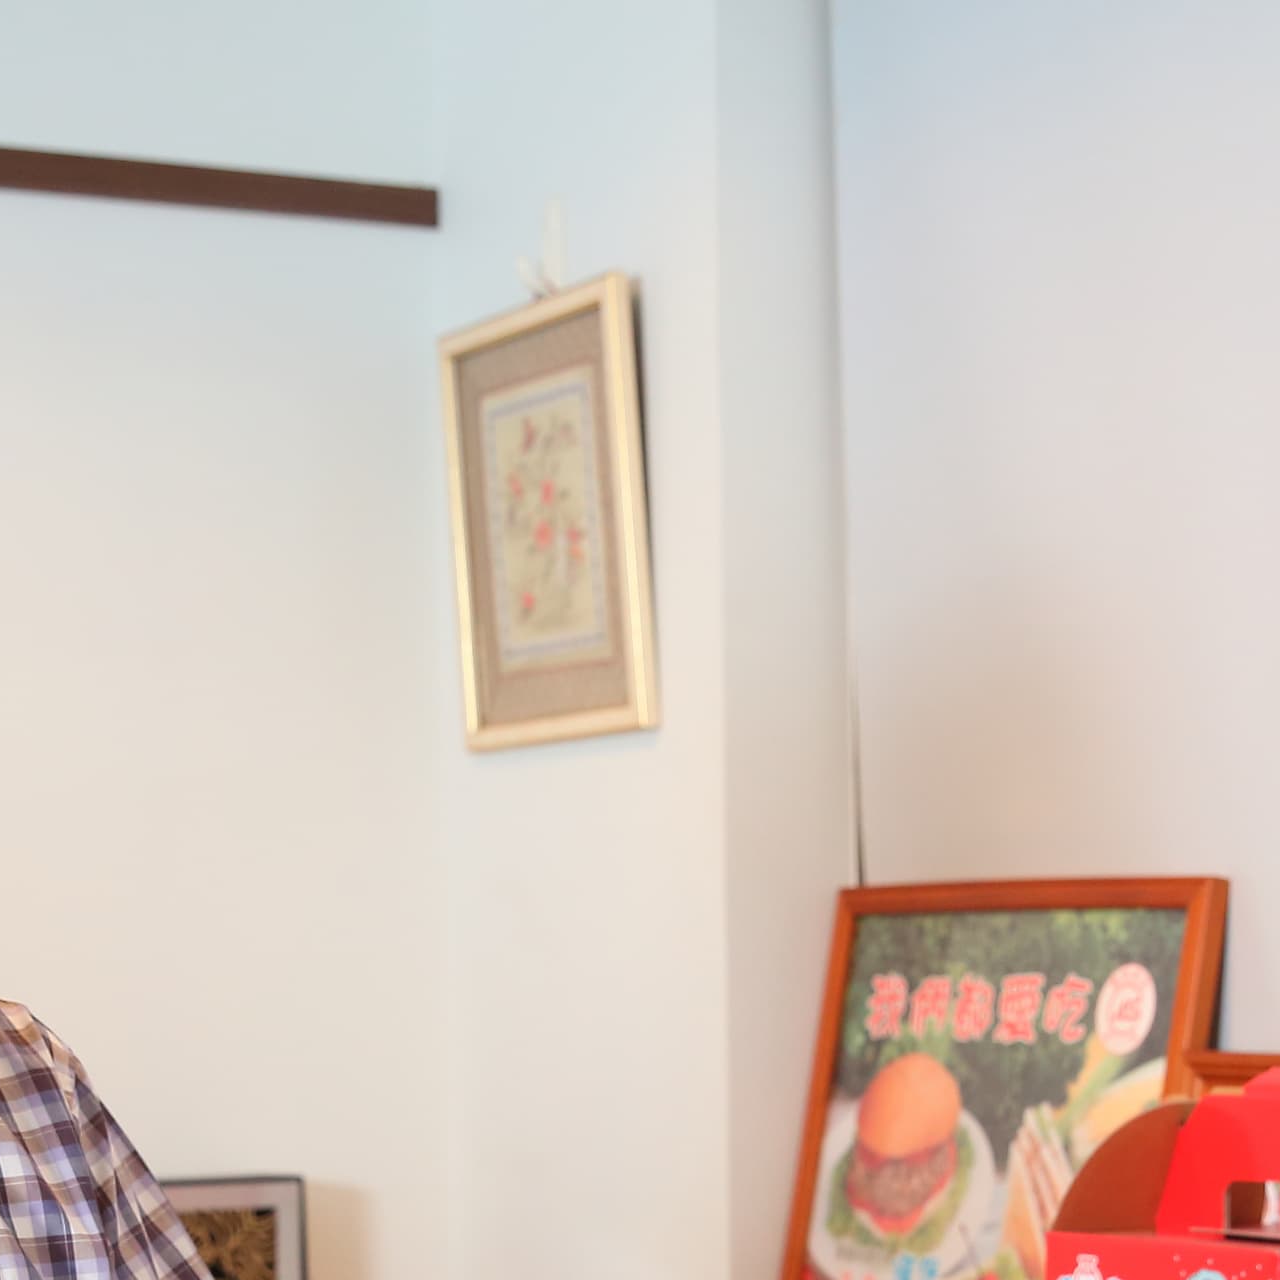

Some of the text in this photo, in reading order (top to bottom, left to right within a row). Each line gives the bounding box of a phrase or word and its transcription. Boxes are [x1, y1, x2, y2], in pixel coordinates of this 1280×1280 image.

[865, 969, 1094, 1045] 我們都愛吃
